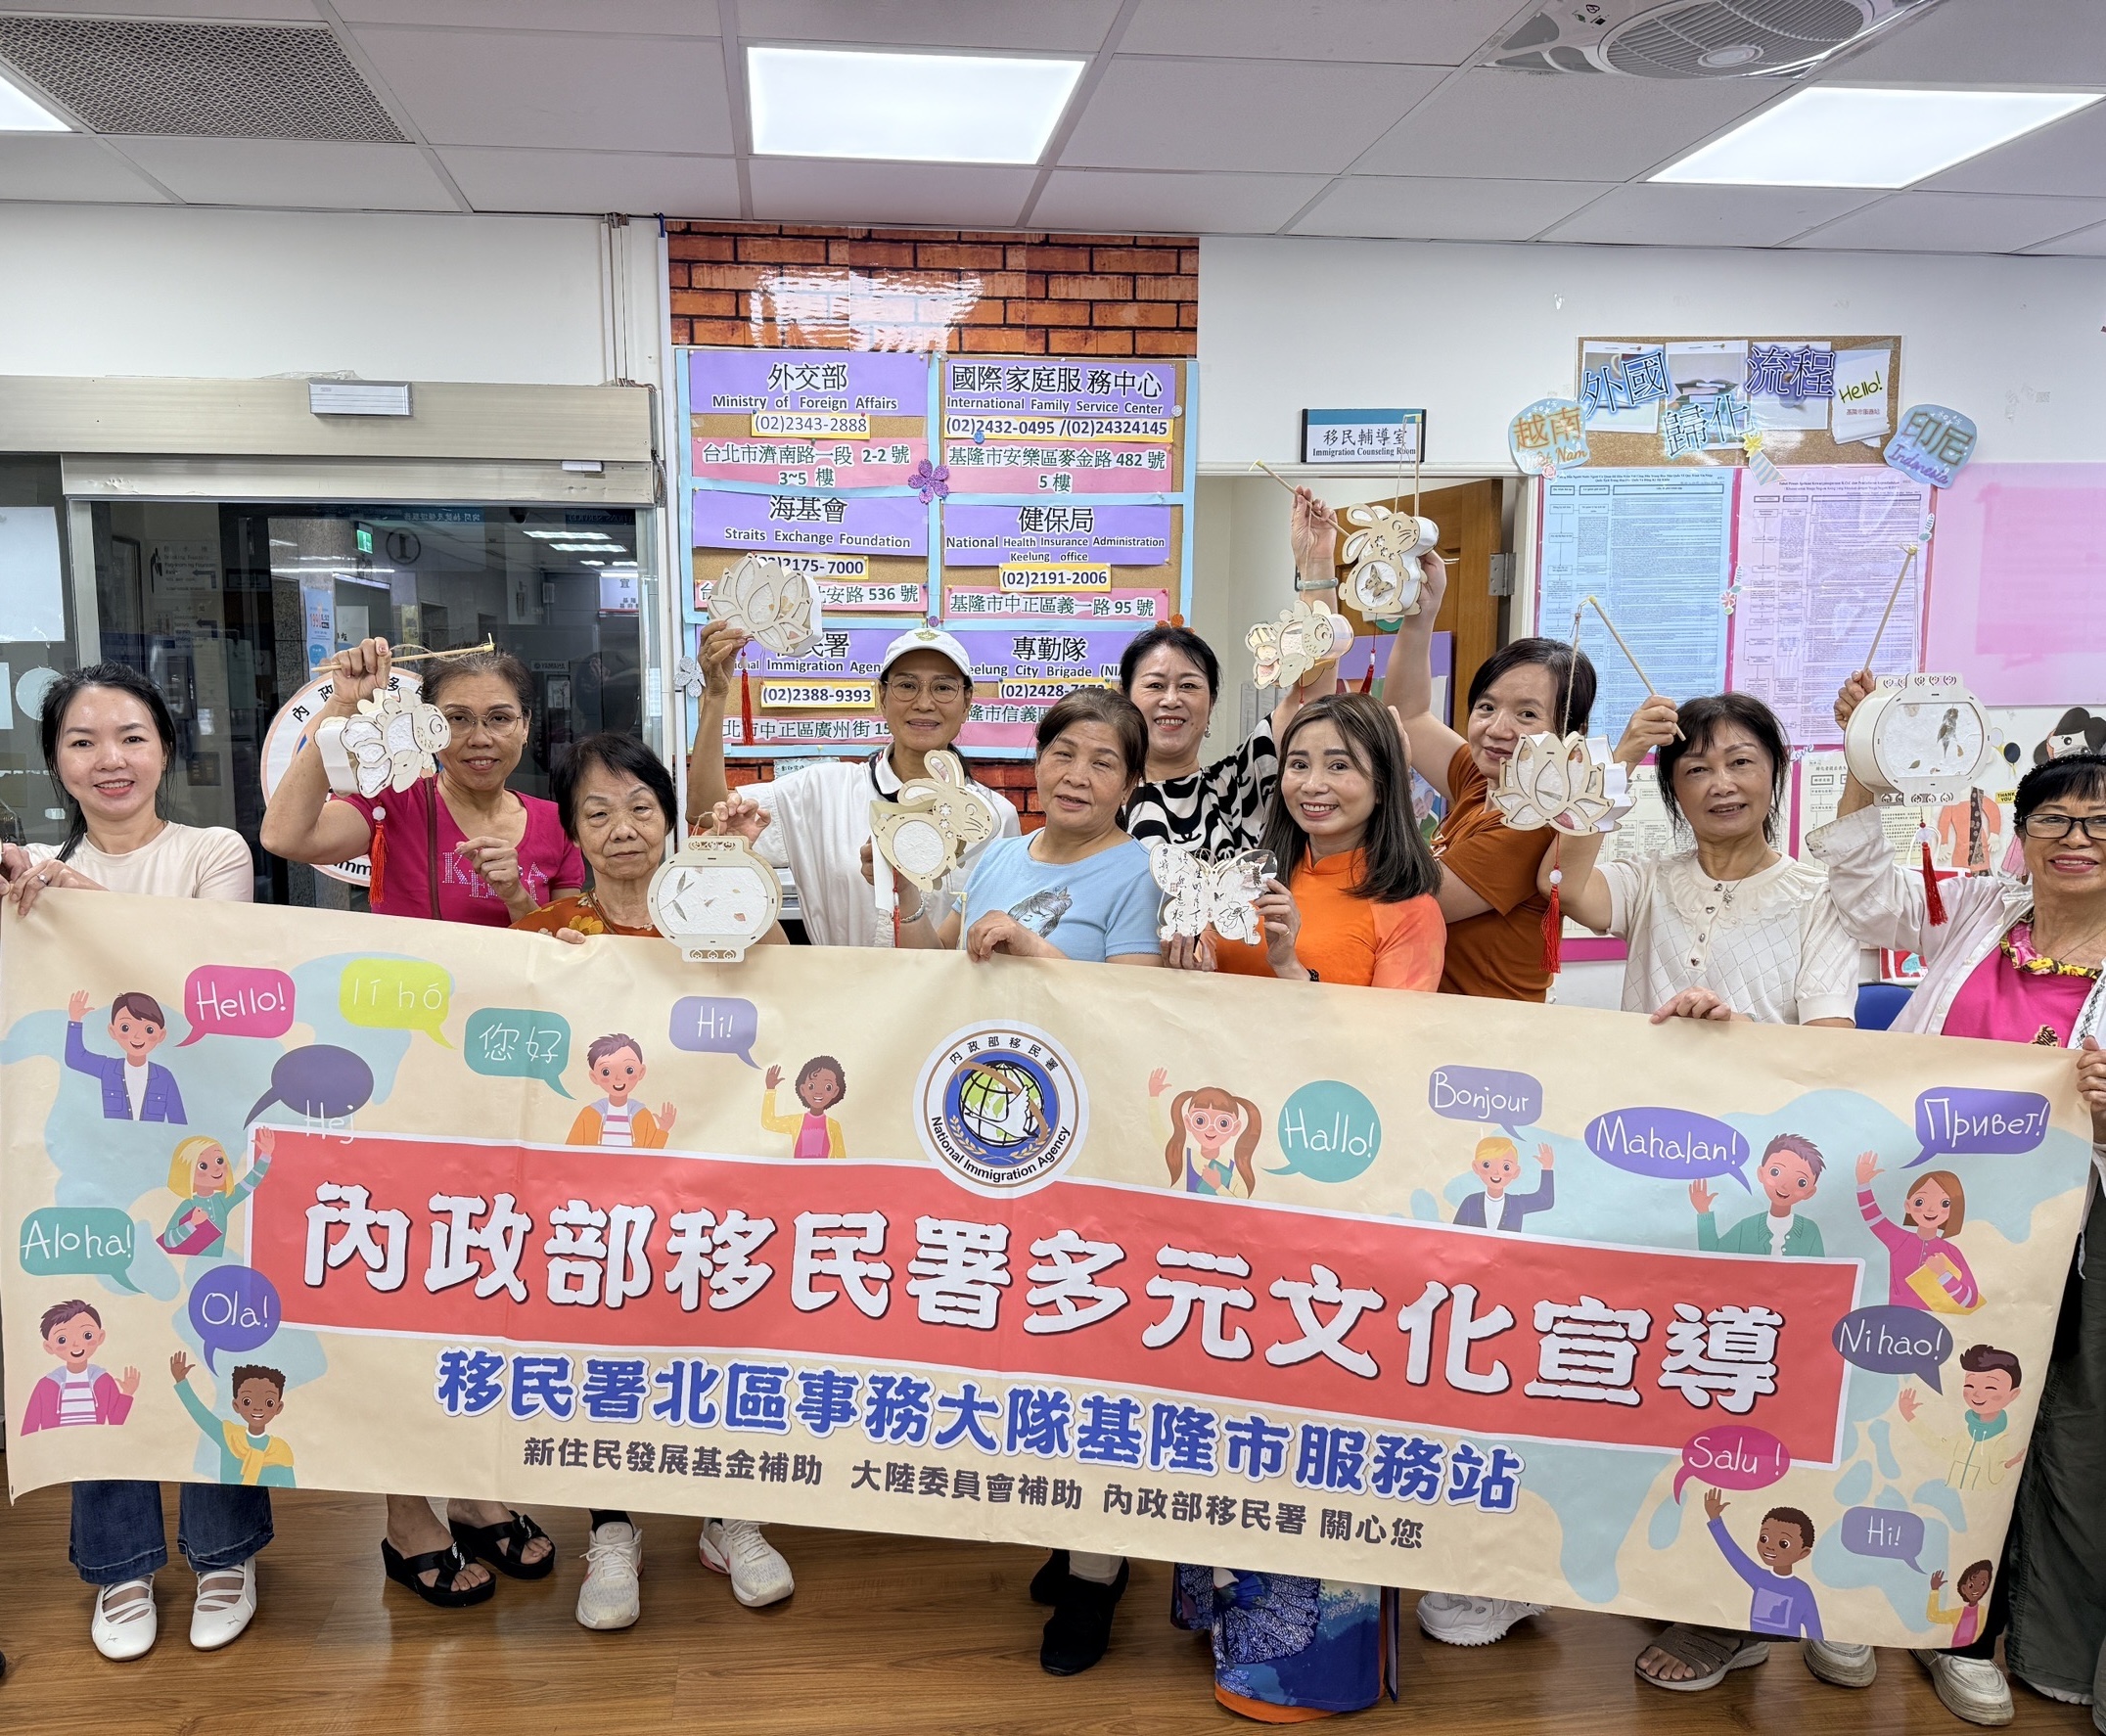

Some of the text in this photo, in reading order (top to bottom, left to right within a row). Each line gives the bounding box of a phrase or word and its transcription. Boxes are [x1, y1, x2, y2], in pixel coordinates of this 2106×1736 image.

[767, 363, 847, 391] 外交部
[952, 365, 1163, 398] 國際家庭服務中心
[1745, 345, 1835, 397] 流程
[1839, 371, 1883, 403] Hello!
[712, 394, 897, 411] Ministry of Foreign Affairs
[947, 396, 1164, 415] International Family Service Center
[755, 414, 867, 434] (02)2343-2888
[946, 418, 1055, 435] (02)2432-0495
[1323, 428, 1407, 446] 移民輔導室
[1664, 393, 1756, 457] 歸化
[1312, 447, 1355, 458] Immigration
[1357, 447, 1395, 457] Counseling
[1901, 411, 1973, 466] 印尼
[703, 443, 910, 466] 台北市濟南路一段 2-2 號
[948, 446, 1167, 470] 基隆市安樂區麥金路 482 號
[1555, 445, 1587, 464] Nam
[815, 467, 835, 487] 樓
[1039, 474, 1072, 492] 5 樓
[769, 495, 847, 524] 海基會
[1018, 506, 1094, 534] 健保局
[725, 527, 911, 548] Straits Exchange Foundation
[946, 536, 1165, 548] National Health Insurance Administration
[1010, 552, 1088, 563] Keelung office
[1002, 571, 1108, 587] (02)2191-2006
[868, 588, 895, 601] 536
[900, 585, 918, 603] 號
[950, 594, 1155, 617] 基隆市中正區義一路 95 號
[1012, 636, 1087, 662] 專勤隊
[767, 660, 844, 673] Immigration
[849, 662, 883, 674] Agen
[969, 664, 1008, 677] eelung
[1015, 665, 1038, 677] City
[1046, 666, 1092, 678] Brigade
[762, 687, 871, 704] (02)2388-9393
[197, 981, 287, 1021] Hello!
[697, 1005, 734, 1039] Hi!
[478, 1022, 563, 1064] 您好
[949, 1035, 1059, 1073] 內政部移民署
[1433, 1071, 1530, 1119] Bonjour
[303, 1098, 355, 1146] Hej
[1284, 1107, 1376, 1159] Hallo!
[1924, 1097, 2049, 1149] Привет!
[931, 1116, 1071, 1183] National Immigration Agency
[1596, 1115, 1738, 1165] Mahalan!
[20, 1219, 133, 1259] Aloha!
[201, 1289, 269, 1328] Ola!
[303, 1180, 1785, 1415] 內政部移民署多元文化宣導
[437, 1348, 1519, 1510] 移民署北區事務大隊基隆市服務站
[524, 1437, 1425, 1550] 新住民發展基金補助 大陸委員會補助 內政部移民署 關心您
[1868, 1516, 1901, 1546] Hi!
